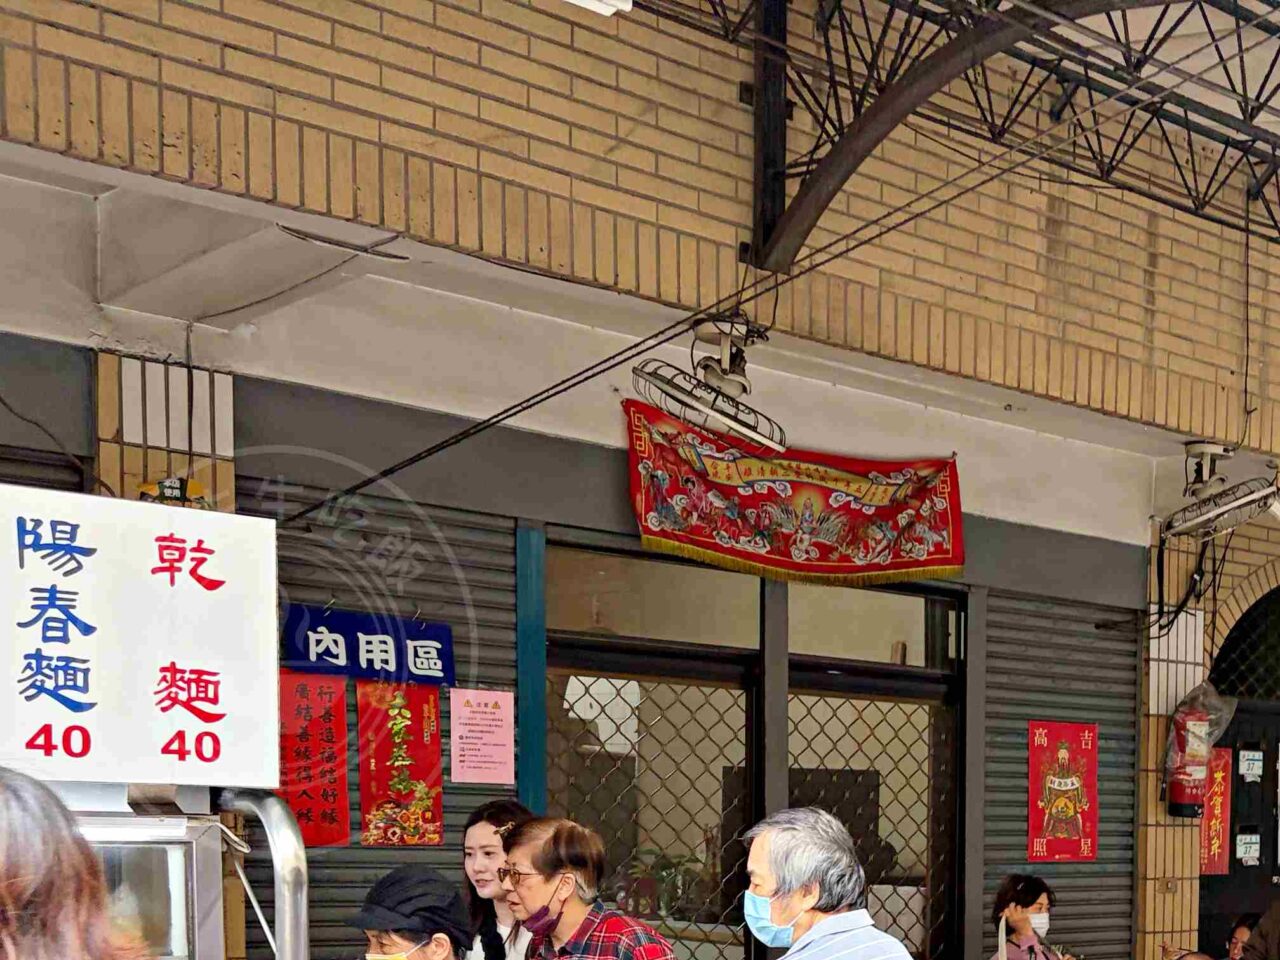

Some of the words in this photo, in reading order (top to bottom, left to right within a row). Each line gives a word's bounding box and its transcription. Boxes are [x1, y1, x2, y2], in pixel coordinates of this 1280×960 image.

[15, 515, 98, 713] 陽春麵
[151, 532, 228, 724] 乾麵
[307, 624, 444, 678] 內用區
[24, 723, 93, 758] 40
[160, 729, 222, 763] 40
